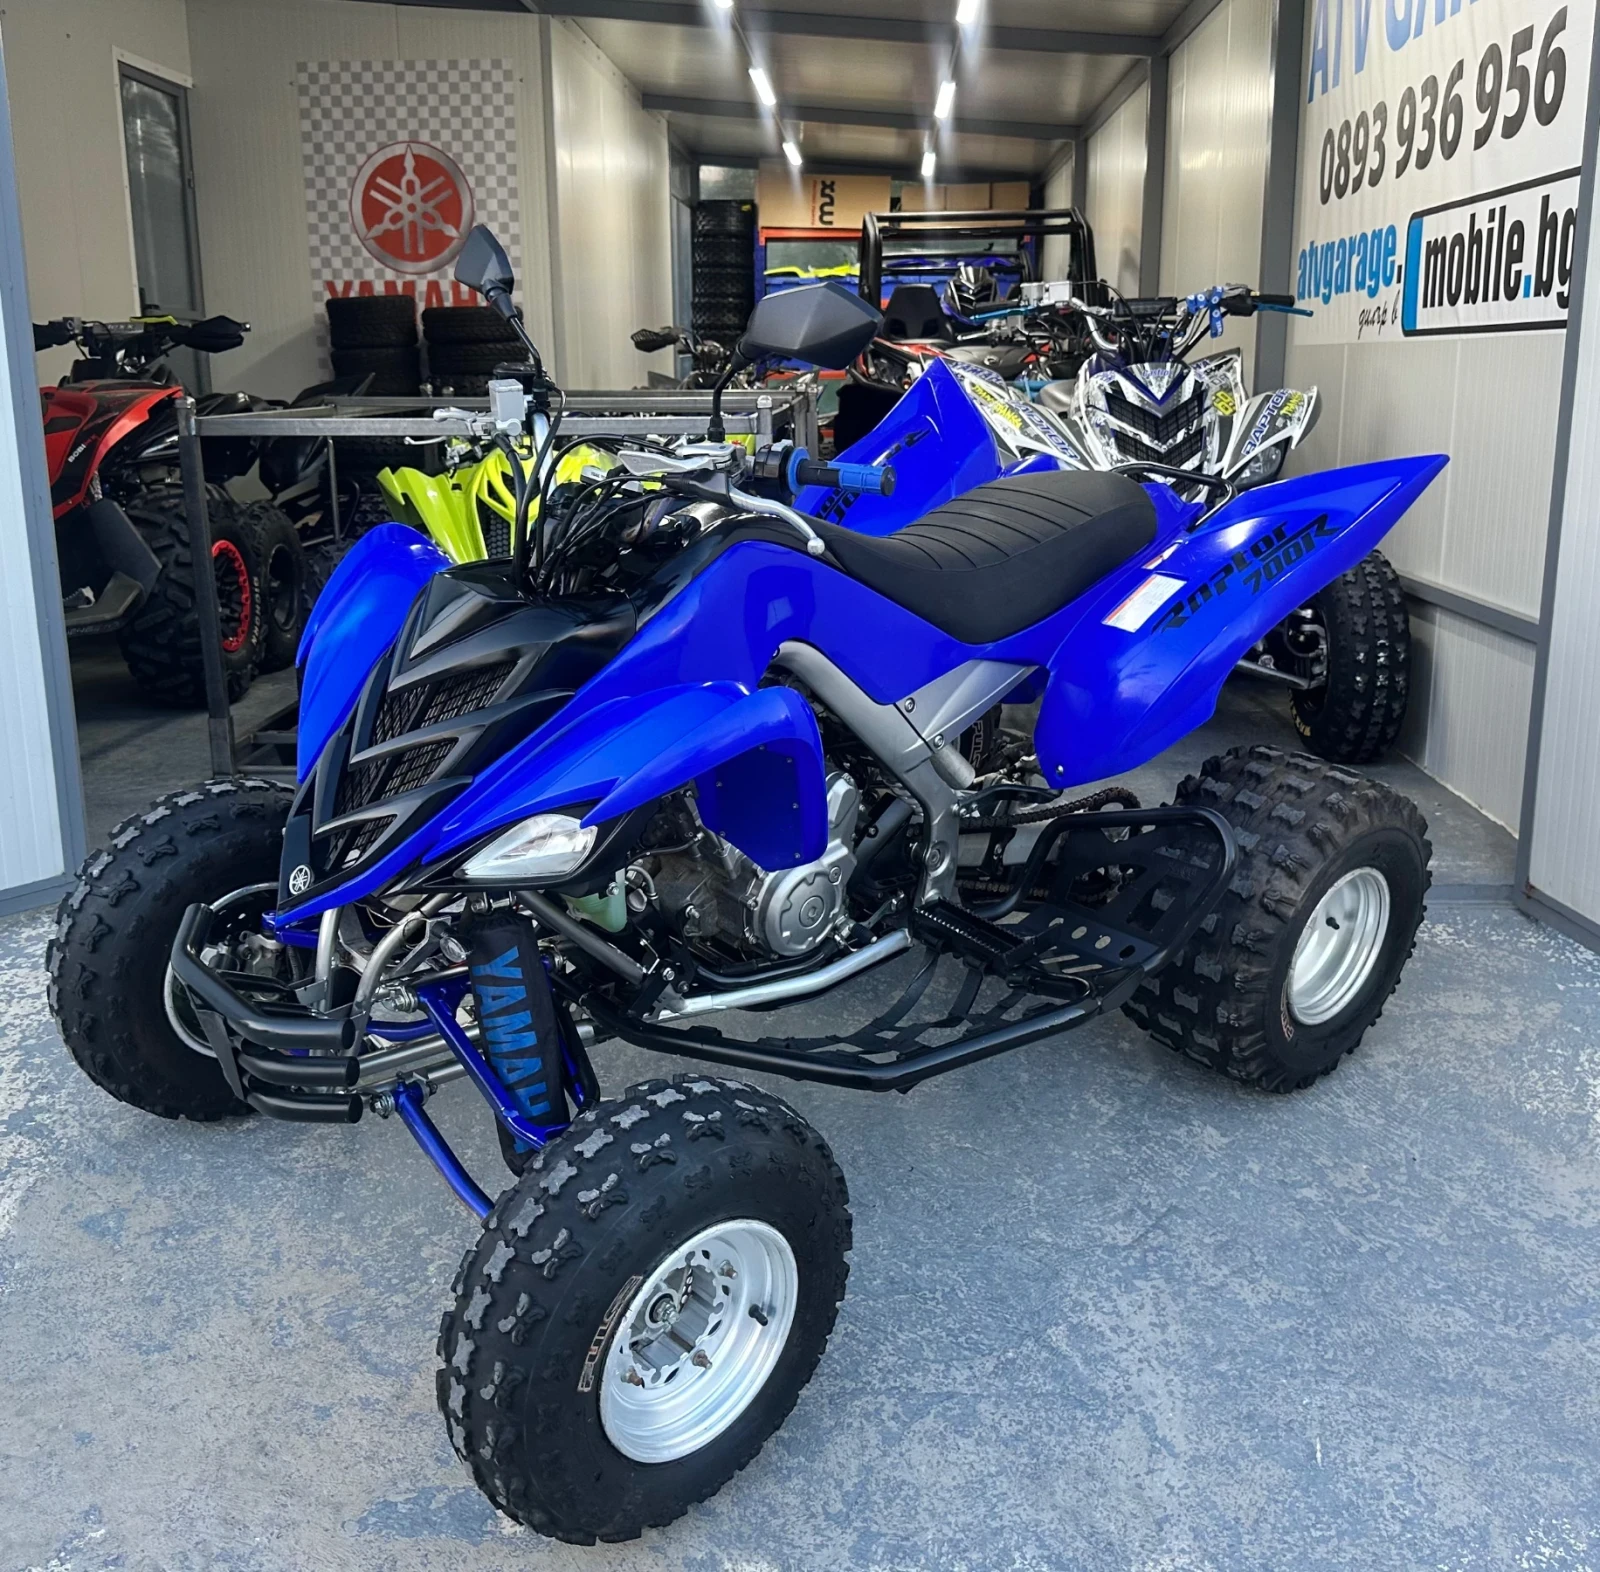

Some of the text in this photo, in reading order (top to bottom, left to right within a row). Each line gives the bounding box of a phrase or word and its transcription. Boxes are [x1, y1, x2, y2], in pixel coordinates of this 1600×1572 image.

[1319, 101, 1388, 205] 0893
[1395, 58, 1464, 179] 936
[1473, 5, 1568, 151] 956
[1243, 513, 1342, 595] 700R
[472, 946, 551, 1154] YAMAH
